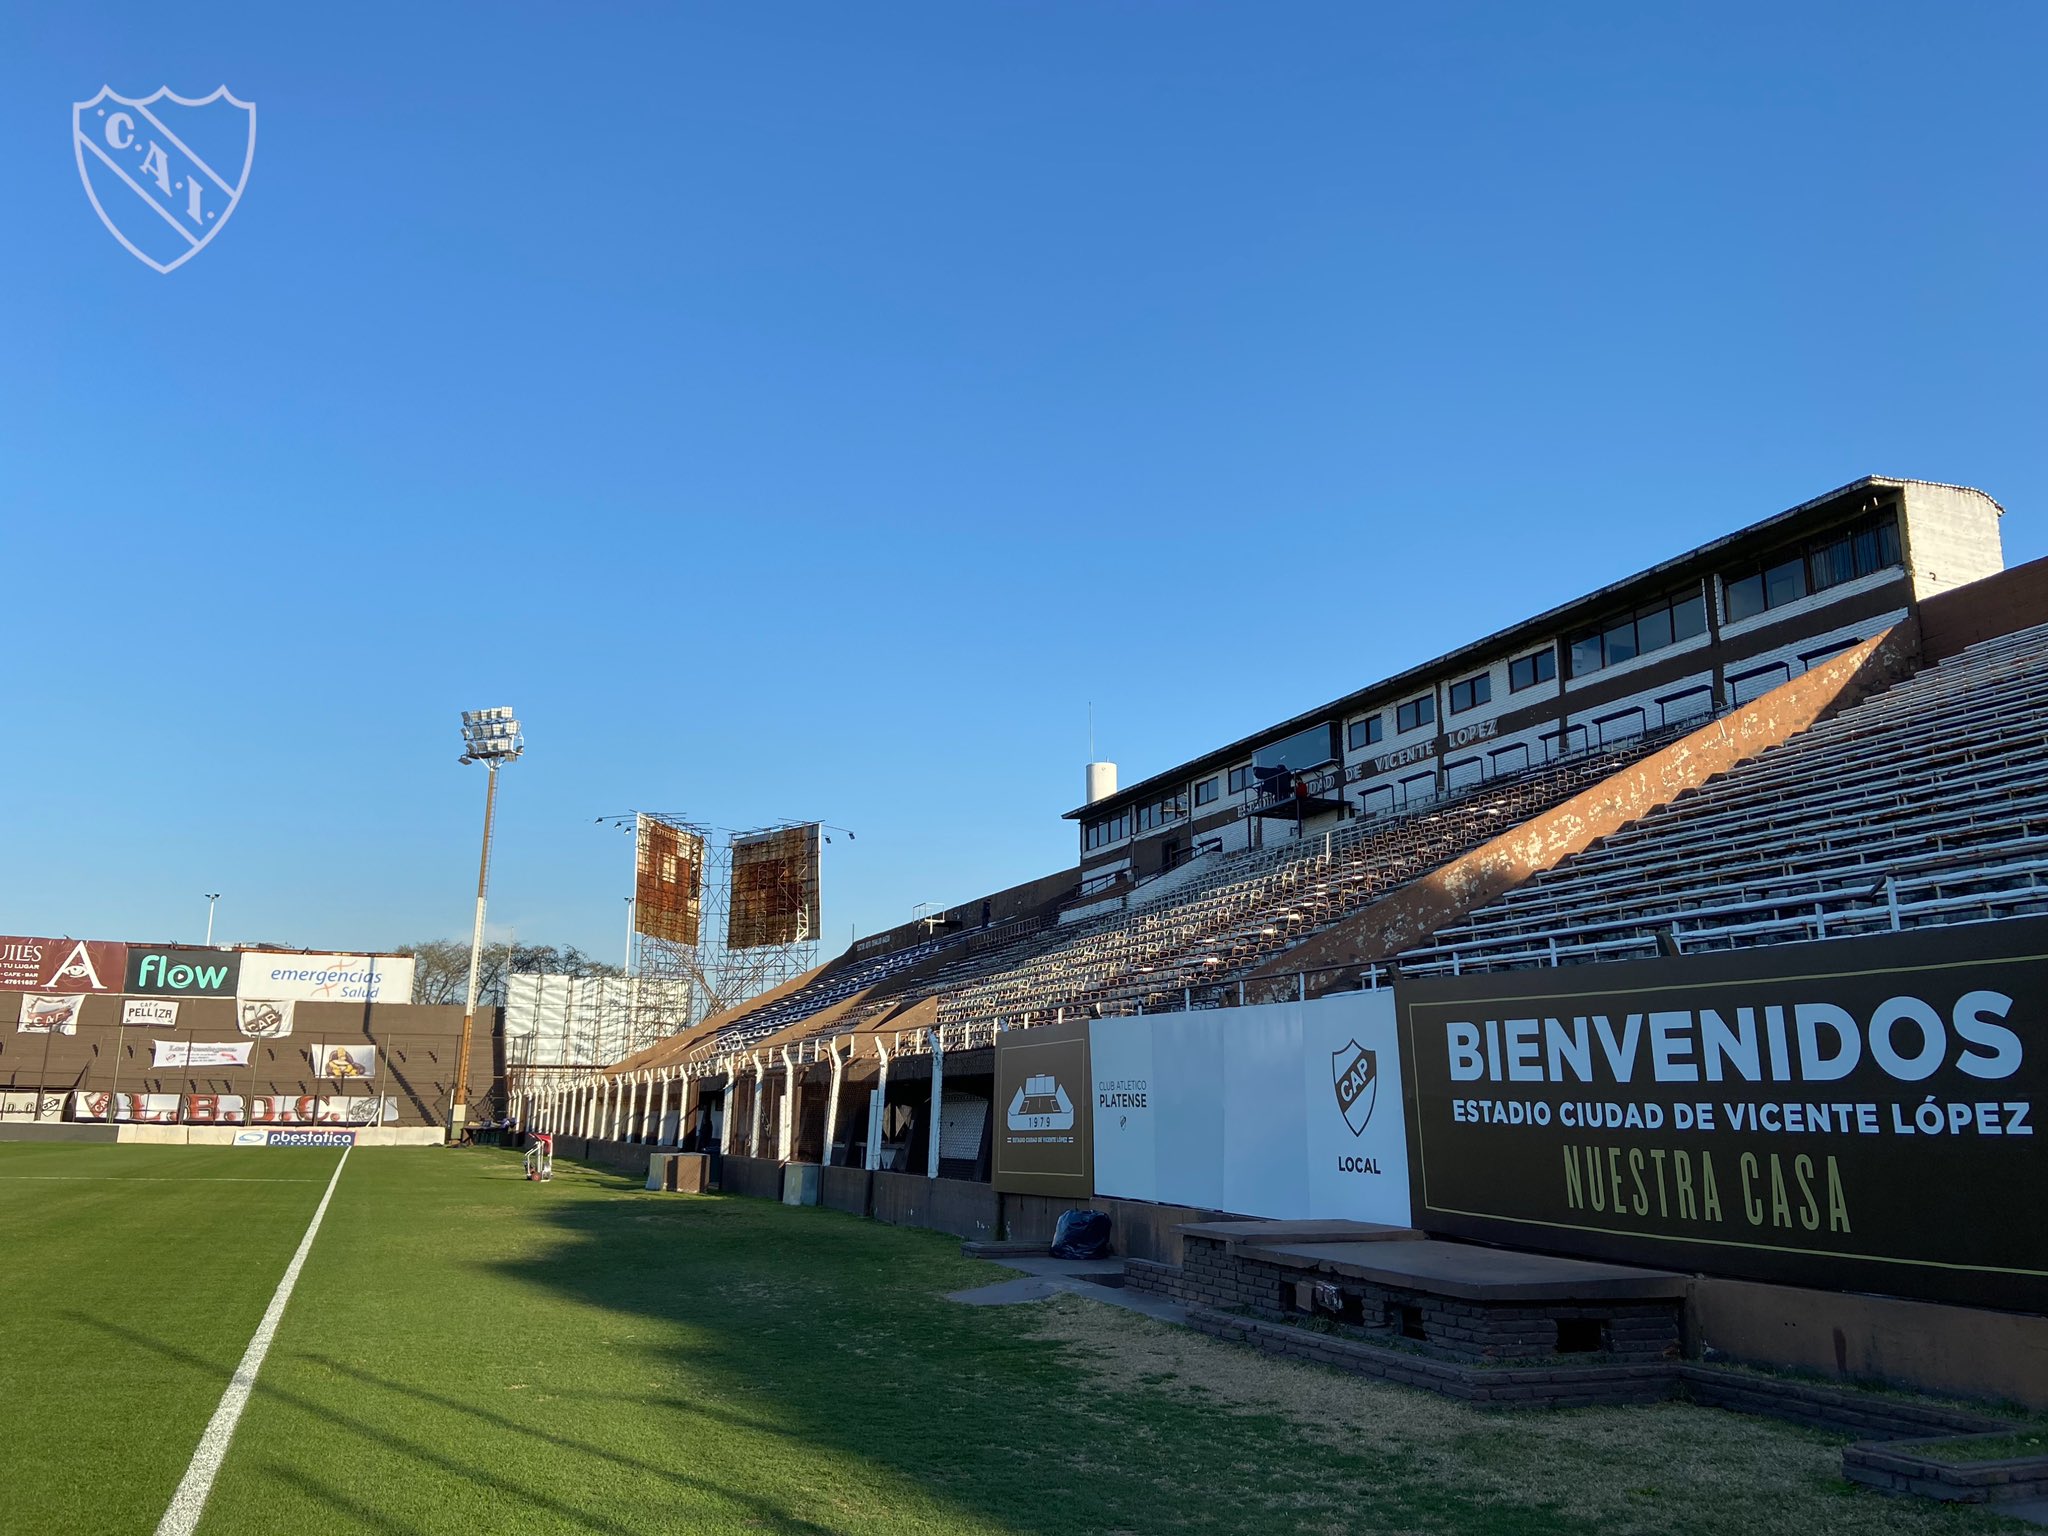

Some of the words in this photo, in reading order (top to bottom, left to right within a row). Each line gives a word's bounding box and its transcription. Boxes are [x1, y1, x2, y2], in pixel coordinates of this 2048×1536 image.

[1345, 764, 1362, 782] DE
[1375, 740, 1435, 772] VICENTE
[1448, 719, 1498, 748] LOPEZ
[139, 955, 228, 989] flow
[271, 969, 382, 985] emergencias
[341, 986, 380, 998] Salud
[128, 1007, 172, 1019] PELLIZA
[247, 1013, 277, 1032] CAP
[1445, 990, 2023, 1083] BIENVENIDOS
[1099, 1081, 1115, 1091] CLUB
[1340, 1058, 1368, 1102] CAP
[42, 1100, 57, 1110] CAP
[1099, 1093, 1147, 1108] PLATENSE
[1028, 1117, 1051, 1128] 1979
[1452, 1099, 1552, 1126] ESTADIO
[1558, 1100, 1664, 1130] CIUDAD
[1674, 1101, 1715, 1131] DE
[1723, 1103, 1880, 1134] VICENTE
[1891, 1095, 2034, 1136] LÓPEZ
[1338, 1156, 1381, 1174] LOCAL
[1562, 1144, 1723, 1223] NUESTRA
[1739, 1151, 1852, 1234] CASA
